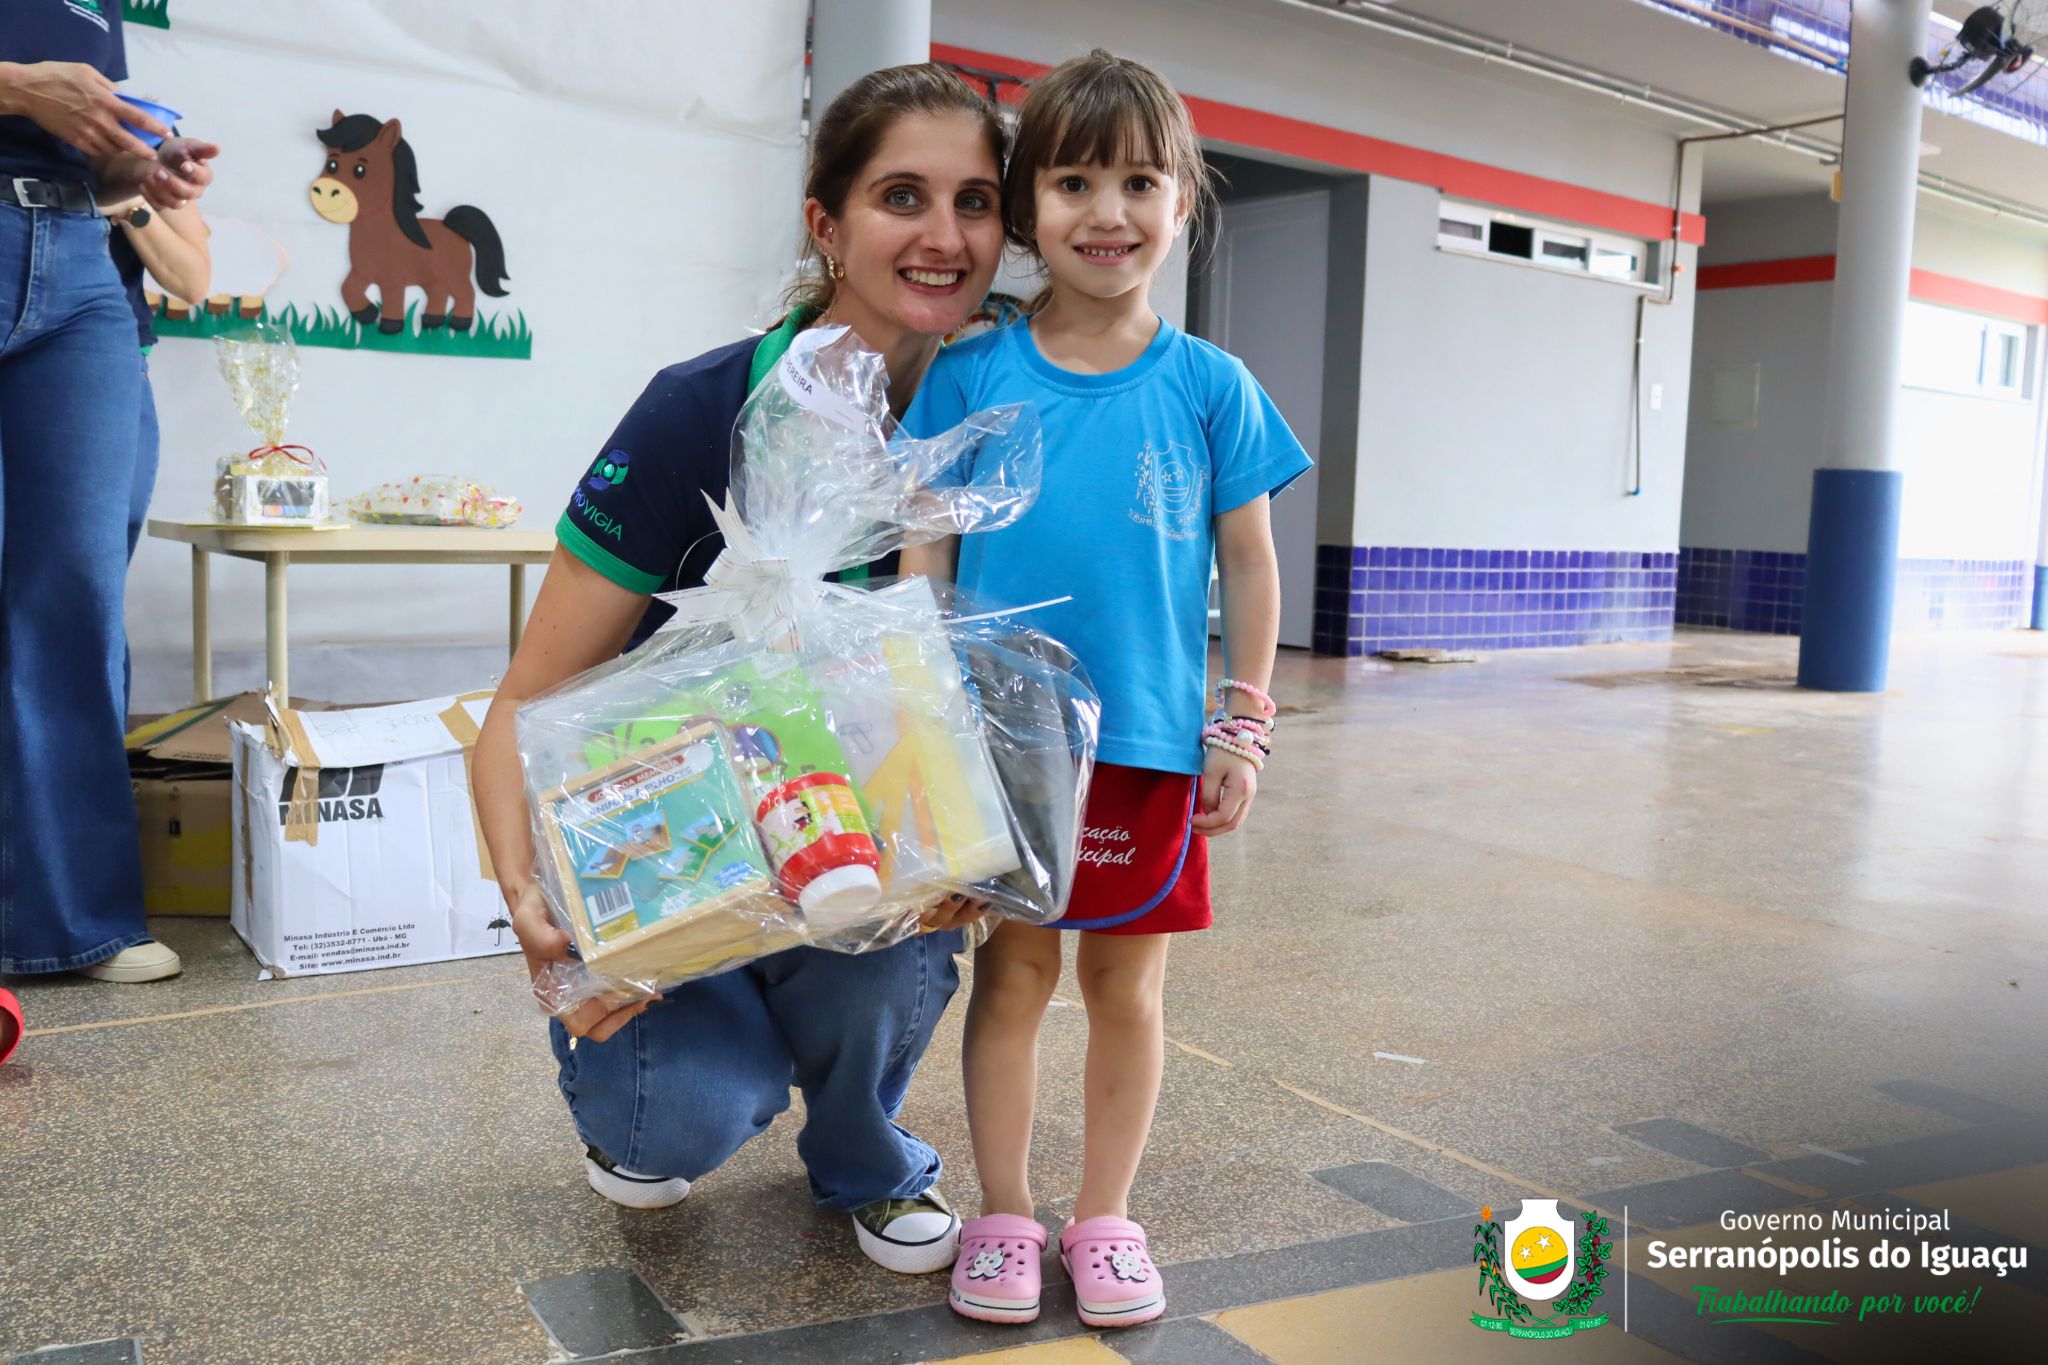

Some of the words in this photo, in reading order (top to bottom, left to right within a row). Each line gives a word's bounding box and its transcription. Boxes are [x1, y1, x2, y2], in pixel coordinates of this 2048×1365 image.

[785, 358, 813, 396] PEREIRA
[283, 933, 313, 942] Minasa
[315, 930, 350, 940] Indústria
[360, 925, 397, 935] Comércio
[398, 923, 416, 931] Ltda
[293, 944, 309, 952] Tel:
[372, 935, 388, 943] Ubá
[290, 953, 319, 962] E-mail:
[299, 962, 319, 970] Site:
[320, 952, 402, 968] www.minasa.ind.br
